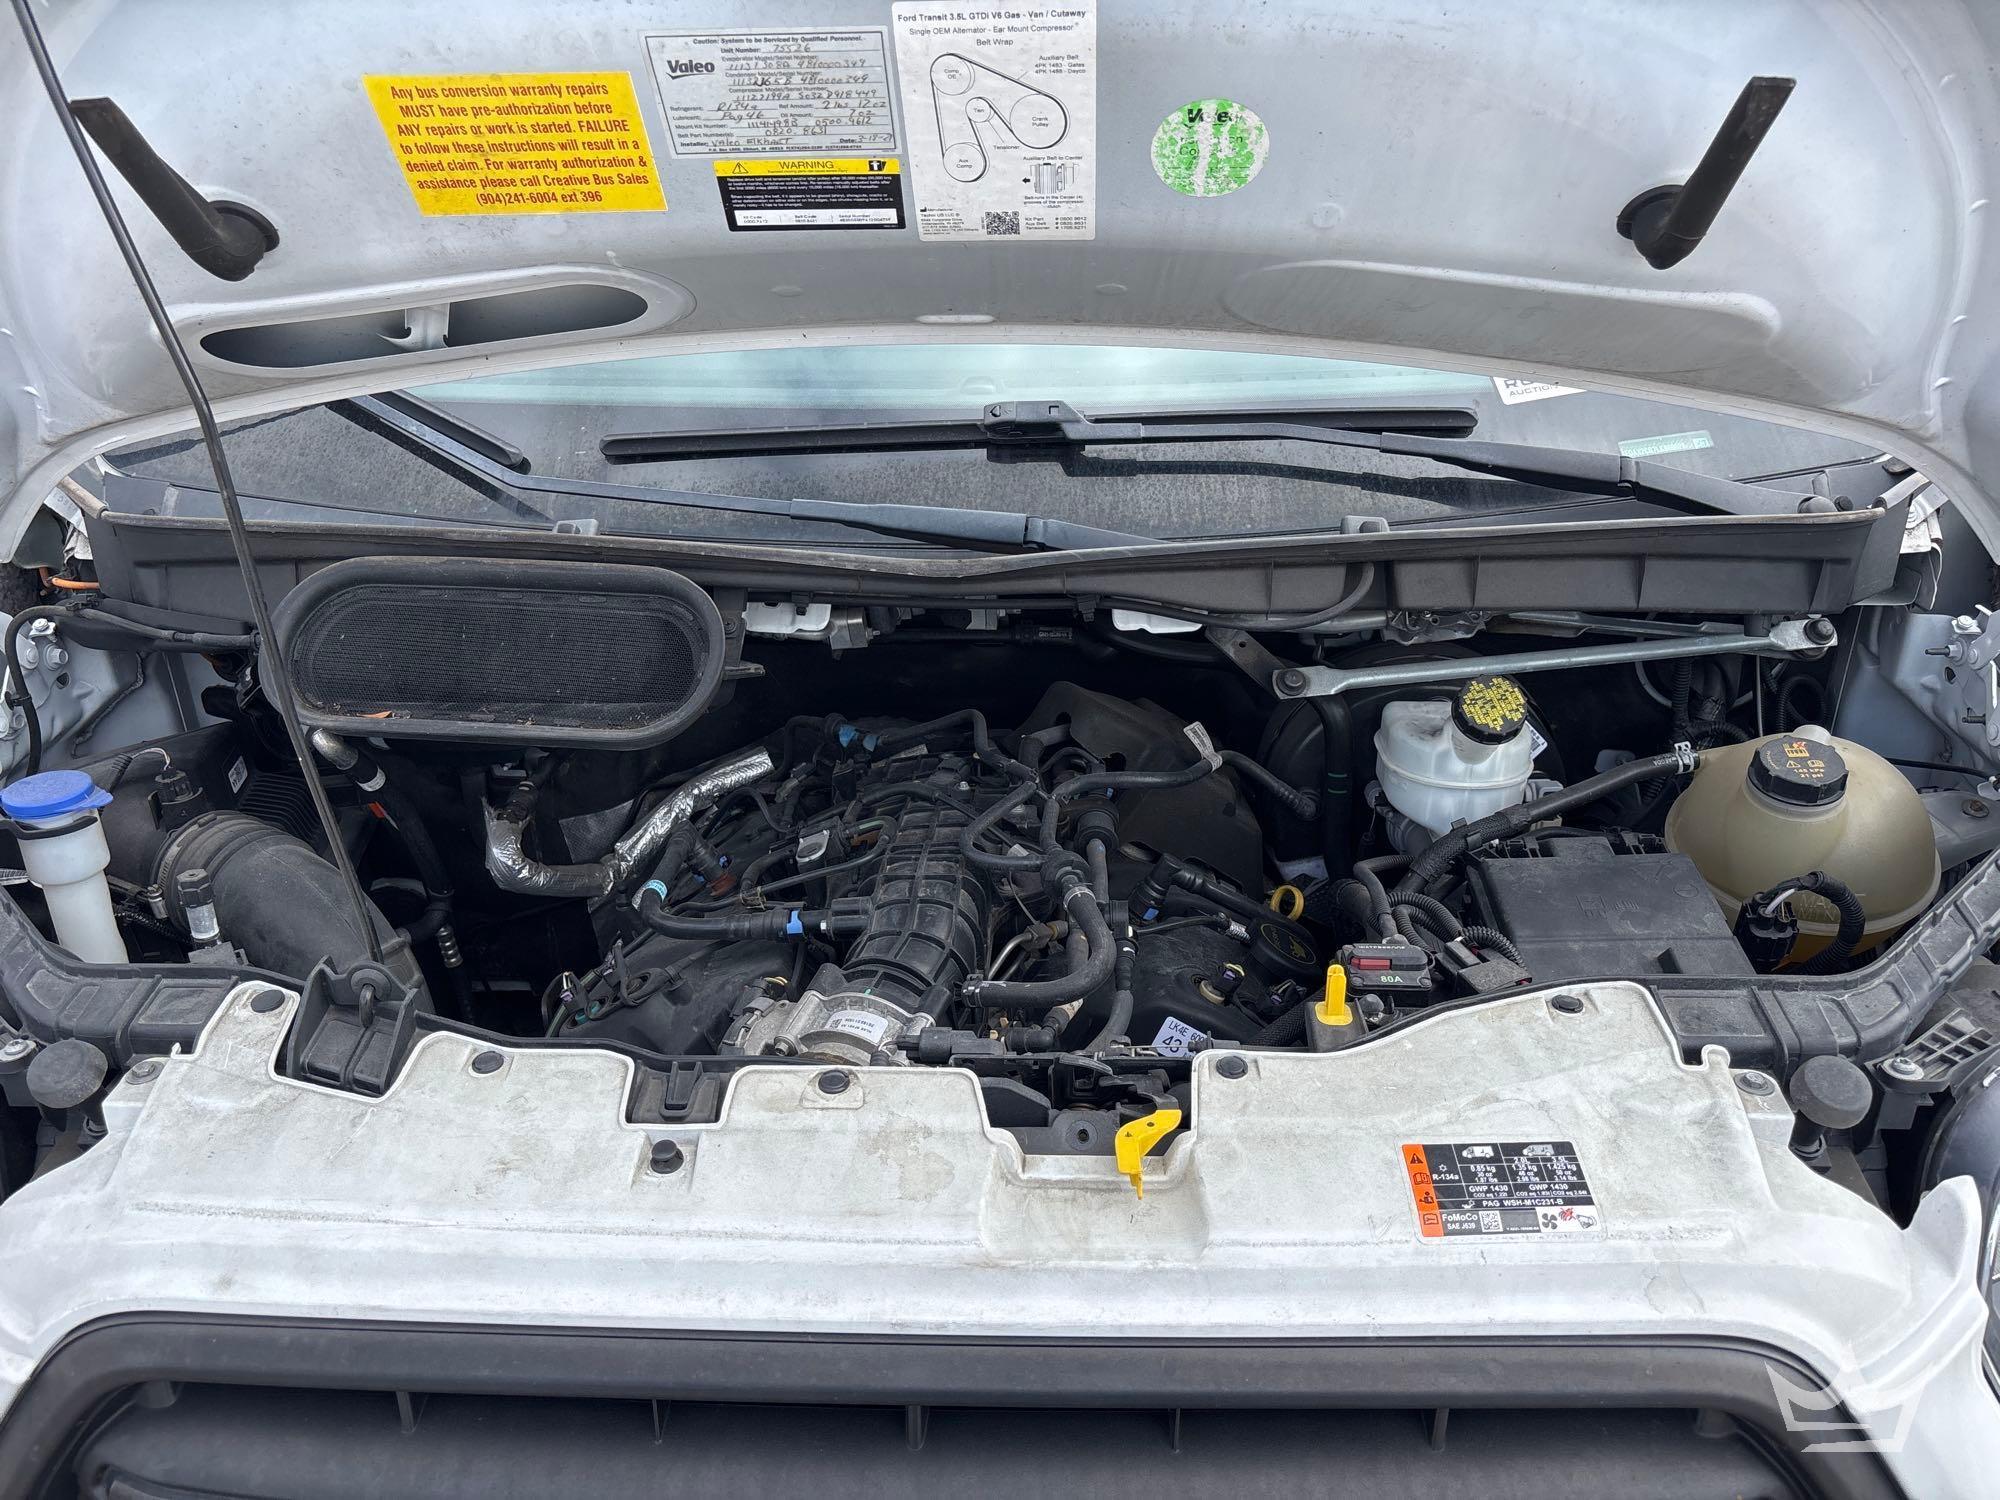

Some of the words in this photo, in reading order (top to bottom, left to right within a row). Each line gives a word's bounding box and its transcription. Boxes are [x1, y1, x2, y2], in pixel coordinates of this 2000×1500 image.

[1051, 10, 1086, 18] Cutaway
[910, 28, 930, 36] Single
[667, 60, 715, 73] Valeo
[391, 86, 413, 100] Any
[416, 85, 438, 98] bus
[442, 84, 507, 97] conversion
[509, 84, 563, 98] warranty
[566, 83, 608, 97] repairs
[400, 105, 435, 118] MUST
[438, 104, 467, 117] have
[472, 102, 572, 119] pre-authorization
[576, 102, 612, 114] before
[397, 124, 421, 136] ANY
[425, 124, 467, 138] repairs
[471, 125, 482, 135] or
[485, 123, 515, 135] work
[517, 123, 528, 134] is
[532, 122, 576, 134] started.
[578, 120, 630, 132] FAILURE
[400, 143, 413, 155] to
[415, 142, 450, 155] follow
[453, 141, 485, 153] these
[488, 140, 556, 153] instructions
[558, 139, 578, 151] will
[582, 138, 615, 150] result
[618, 138, 629, 150] in
[632, 140, 639, 150] a
[406, 160, 444, 173] denied
[447, 160, 482, 171] claim.
[485, 159, 504, 170] For
[507, 159, 558, 171] warranty
[561, 157, 635, 168] authorization
[639, 156, 647, 167] &
[779, 161, 834, 169] WARNING
[416, 177, 476, 189] assistance
[481, 176, 517, 190] please
[520, 176, 540, 186] call
[543, 175, 590, 186] Creative
[594, 174, 614, 185] Bus
[618, 173, 648, 185] Sales
[476, 192, 558, 206] (904)241-6004
[561, 192, 579, 202] ext
[582, 191, 602, 202] 396
[1169, 1021, 1189, 1037] LK4E
[1487, 1165, 1496, 1173] kg
[1528, 1164, 1537, 1172] kg
[1442, 1213, 1478, 1221] FoMoCo
